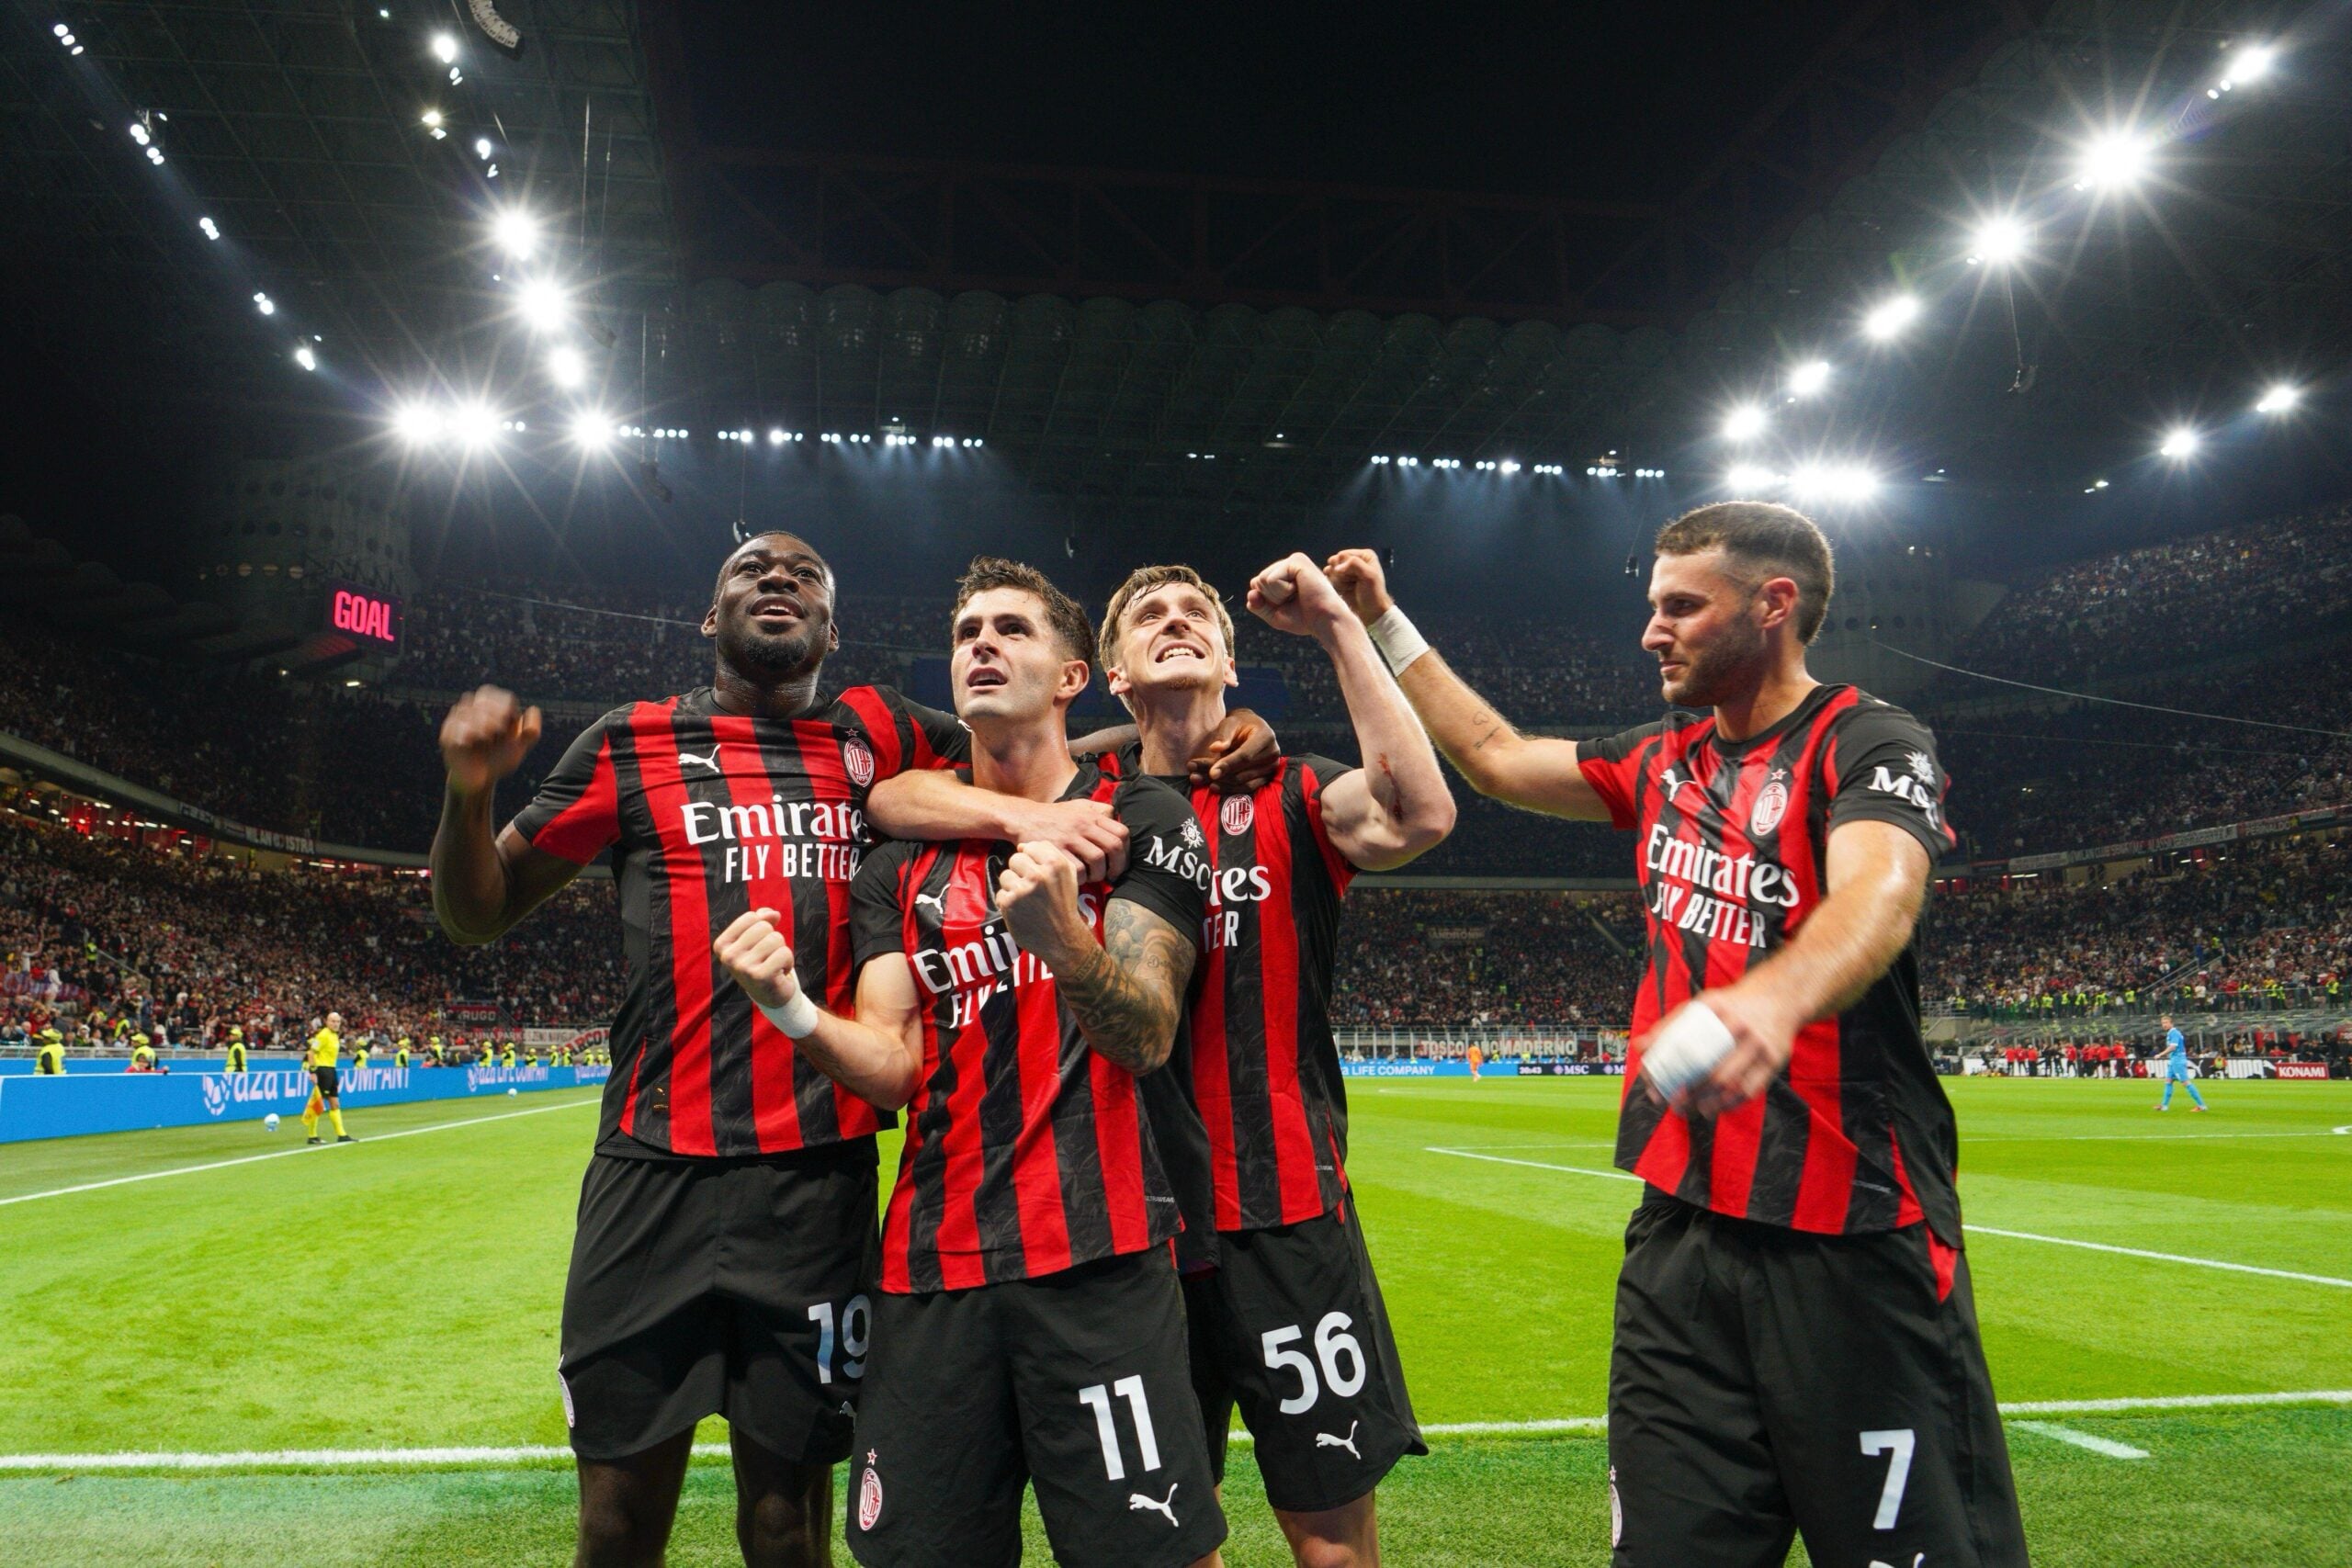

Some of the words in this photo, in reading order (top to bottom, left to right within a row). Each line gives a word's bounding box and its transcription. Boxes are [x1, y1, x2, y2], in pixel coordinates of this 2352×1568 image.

[334, 591, 394, 641] GOAL
[726, 844, 770, 883] FLY
[783, 841, 862, 882] BETTER
[1144, 835, 1211, 891] MSC
[1646, 824, 1800, 908] Emirates
[1651, 882, 1684, 922] FLY
[1678, 893, 1767, 949] BETTER
[1351, 1066, 1375, 1076] LIFE
[1377, 1066, 1435, 1076] COMPANY
[1564, 1065, 1589, 1075] MSC
[2278, 1066, 2325, 1077] KONAMI
[808, 1293, 872, 1384] 19
[1261, 1311, 1366, 1415] 56
[1079, 1375, 1161, 1481] 11
[1859, 1428, 1916, 1529] 7
